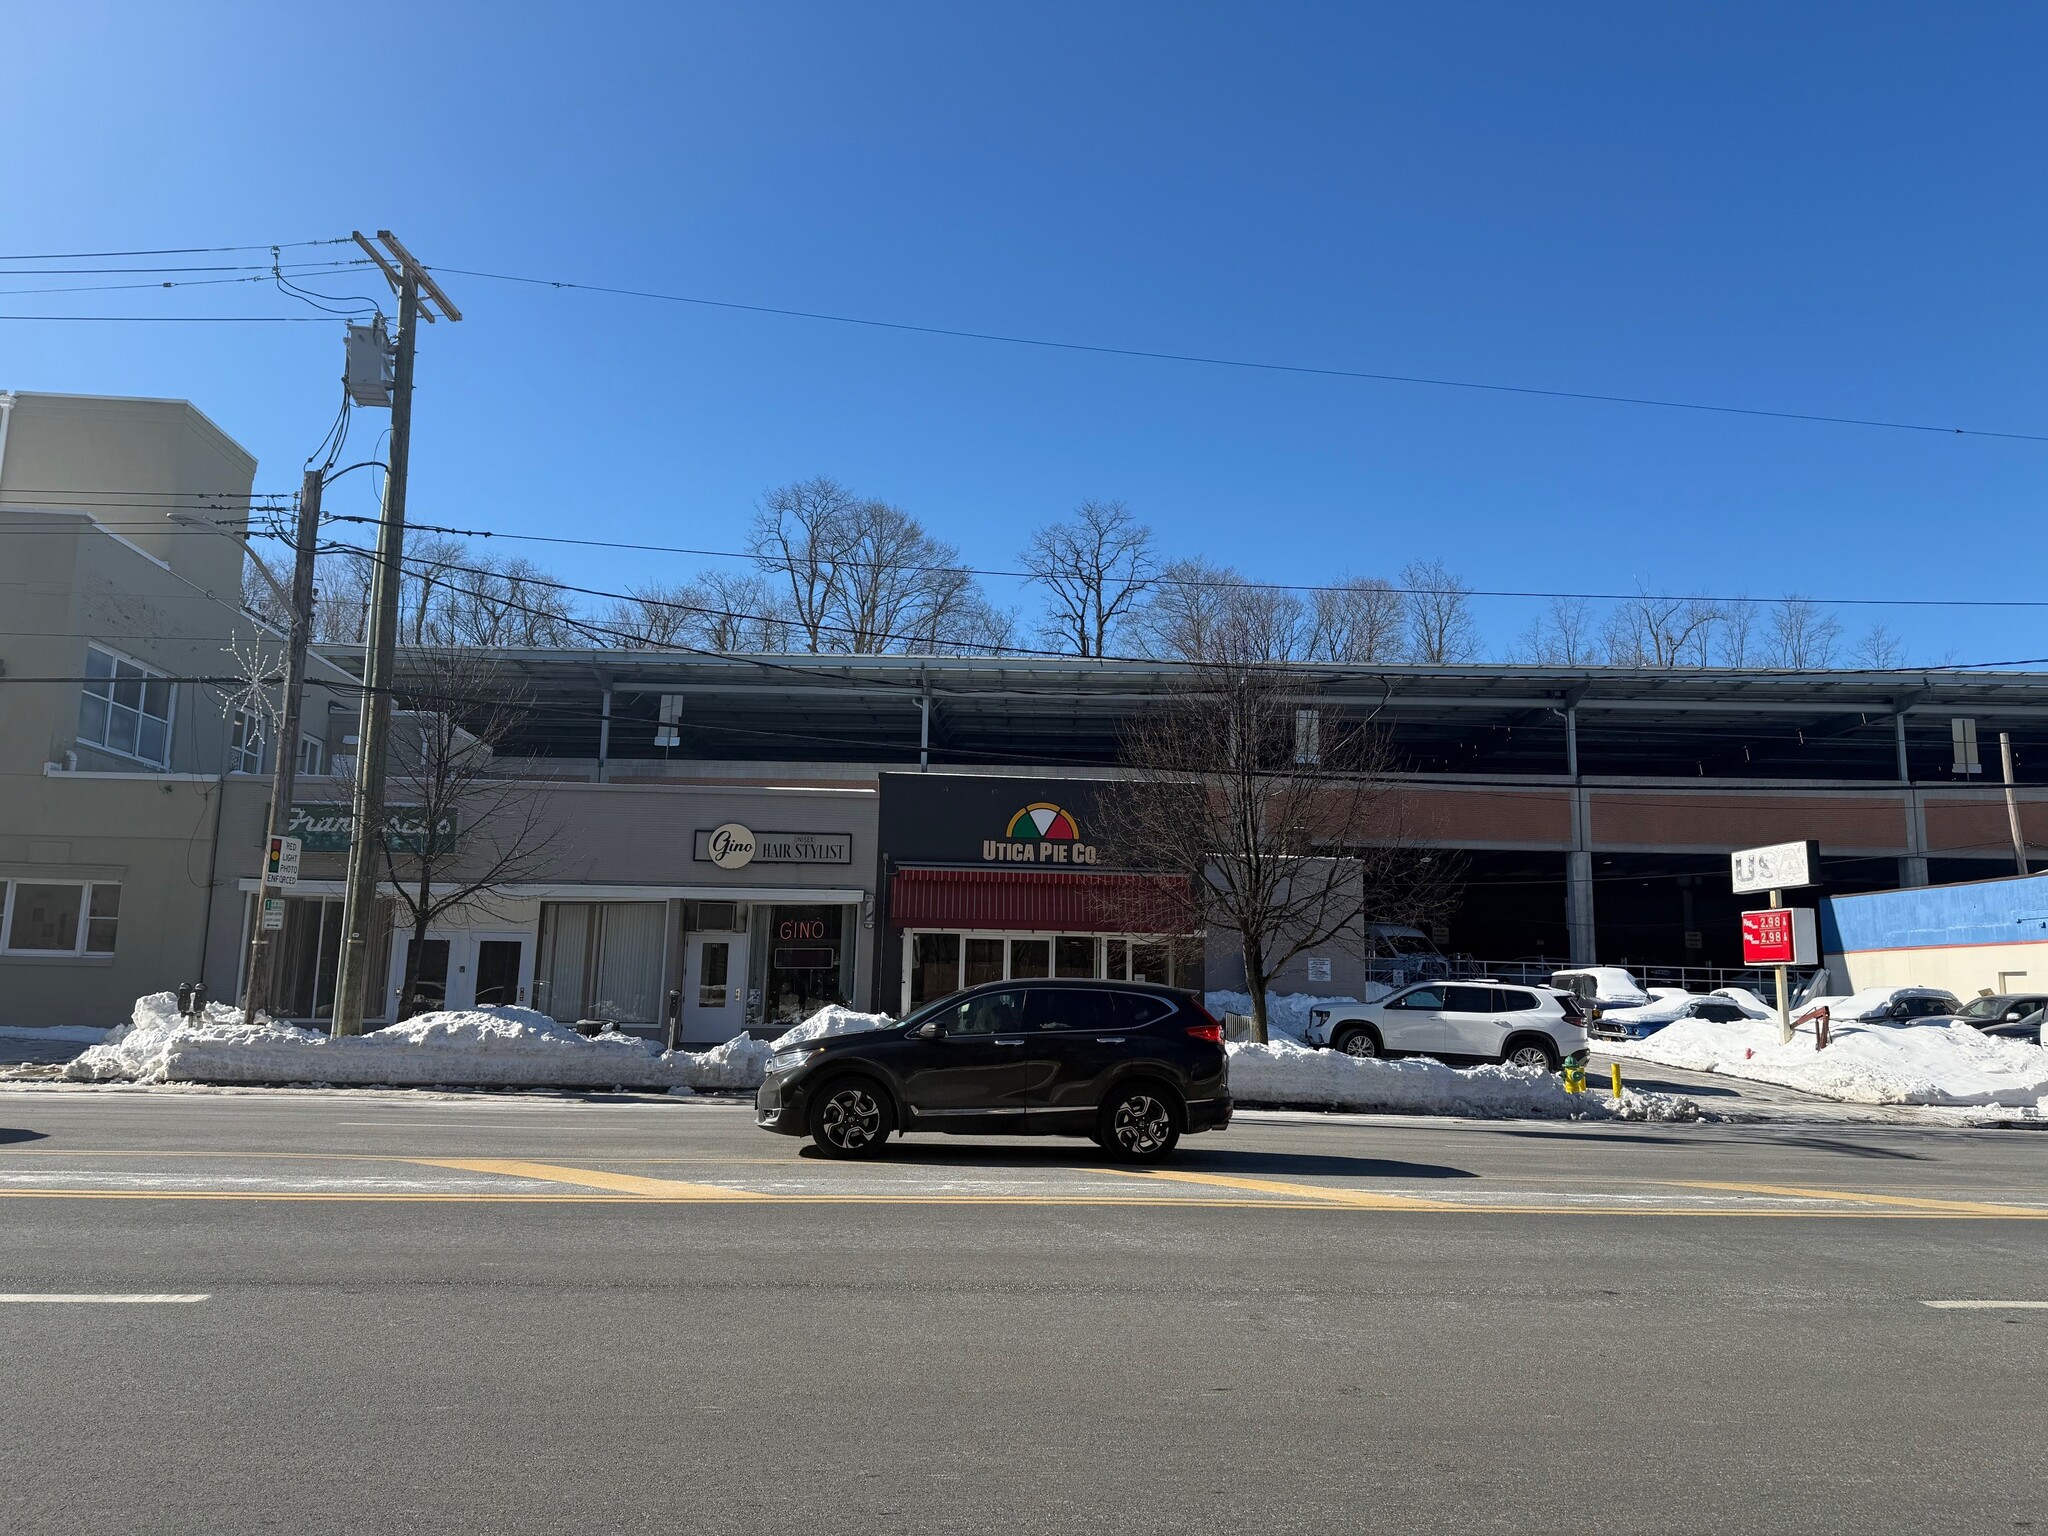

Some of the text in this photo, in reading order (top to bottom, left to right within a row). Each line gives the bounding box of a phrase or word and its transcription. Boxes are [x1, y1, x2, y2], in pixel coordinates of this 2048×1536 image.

[286, 842, 297, 851] RED
[712, 830, 753, 861] Gino
[762, 843, 845, 860] HAIR STYLIST
[983, 840, 1035, 861] UTICA
[1040, 842, 1068, 863] PIE
[282, 854, 298, 863] LIGHT
[280, 864, 297, 874] PHOTO
[267, 873, 297, 885] ENFORCED
[1760, 916, 1780, 928] 2.98
[780, 921, 824, 940] GINO
[1761, 931, 1781, 943] 2.98
